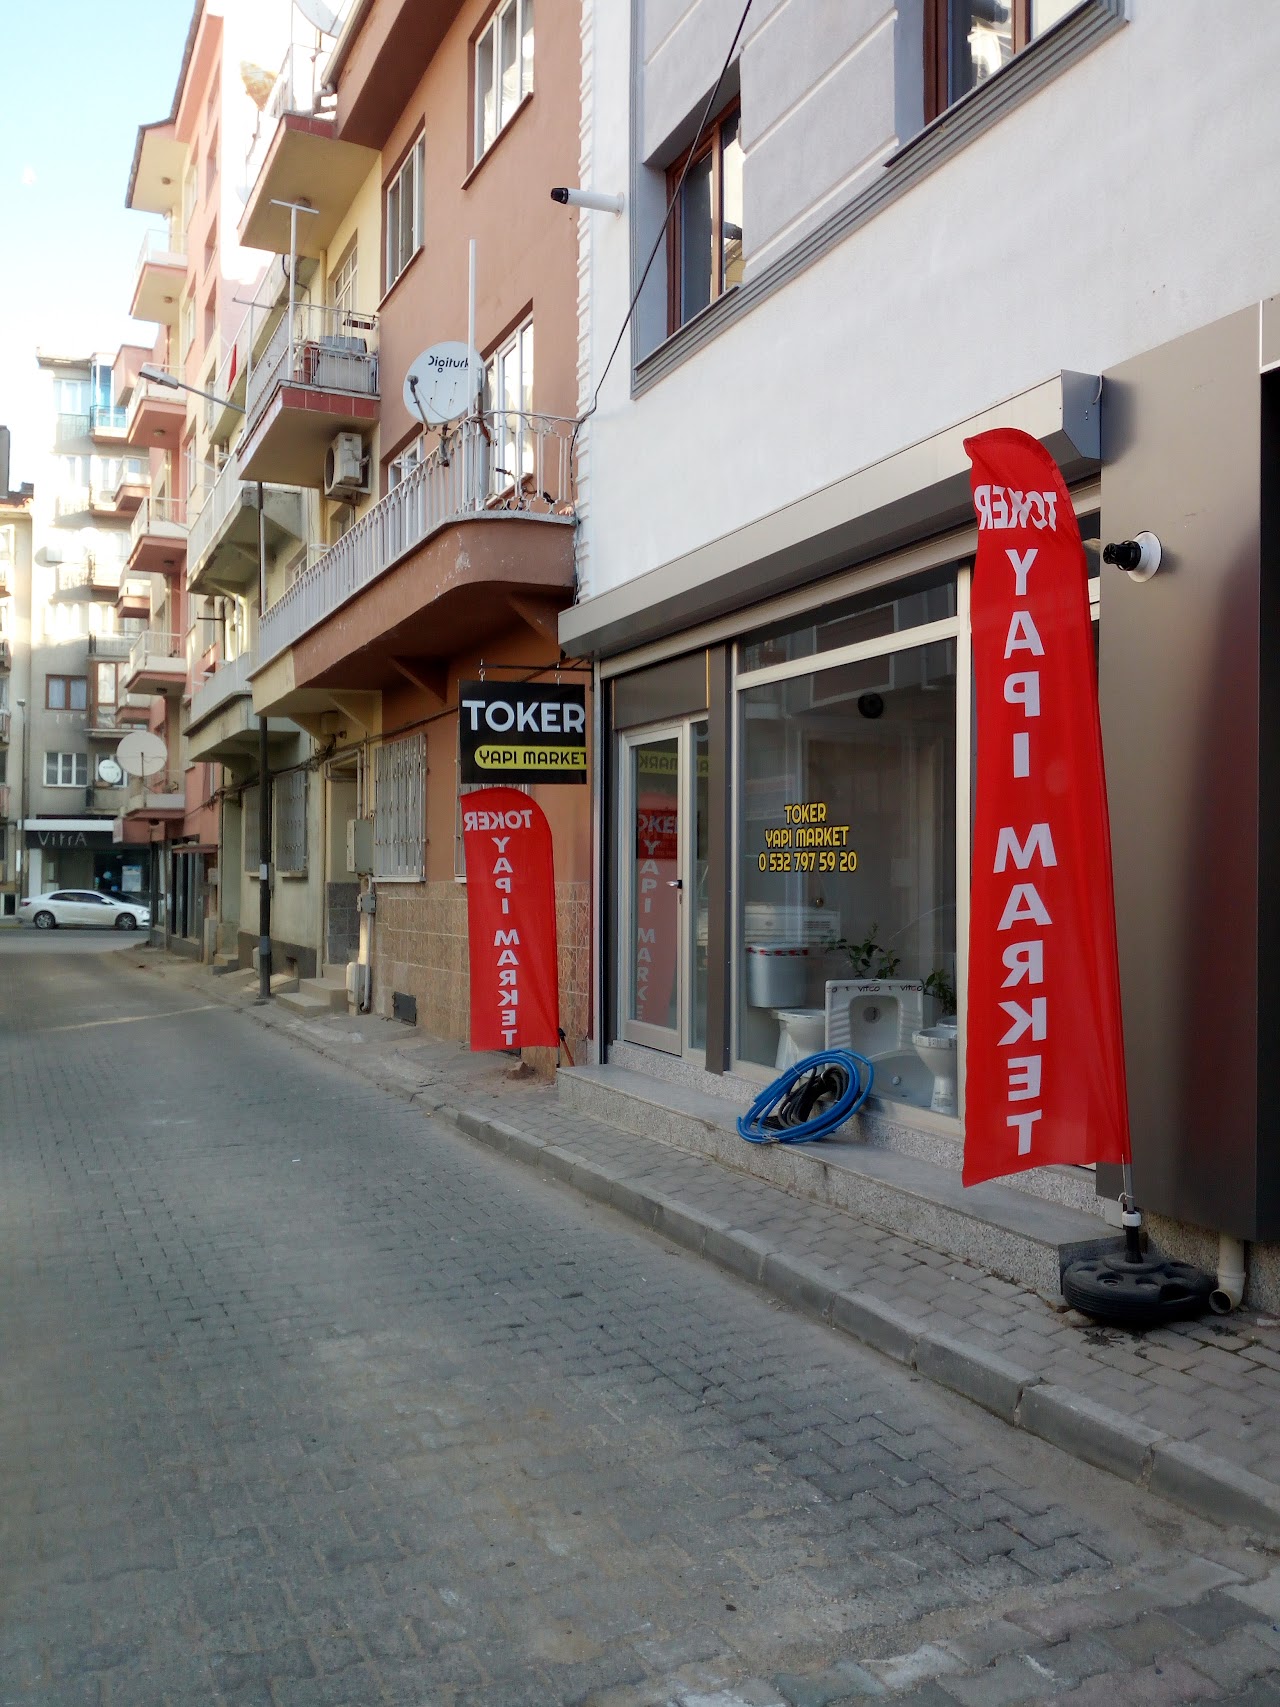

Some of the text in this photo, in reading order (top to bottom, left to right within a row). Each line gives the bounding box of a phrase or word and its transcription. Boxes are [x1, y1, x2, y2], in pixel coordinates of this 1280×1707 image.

[461, 700, 586, 733] TOKER
[479, 750, 587, 765] YAPI MARKET
[783, 802, 827, 825] TOKER
[765, 825, 850, 849] YAPI MARKET
[758, 850, 857, 872] 0 532 797 59 20
